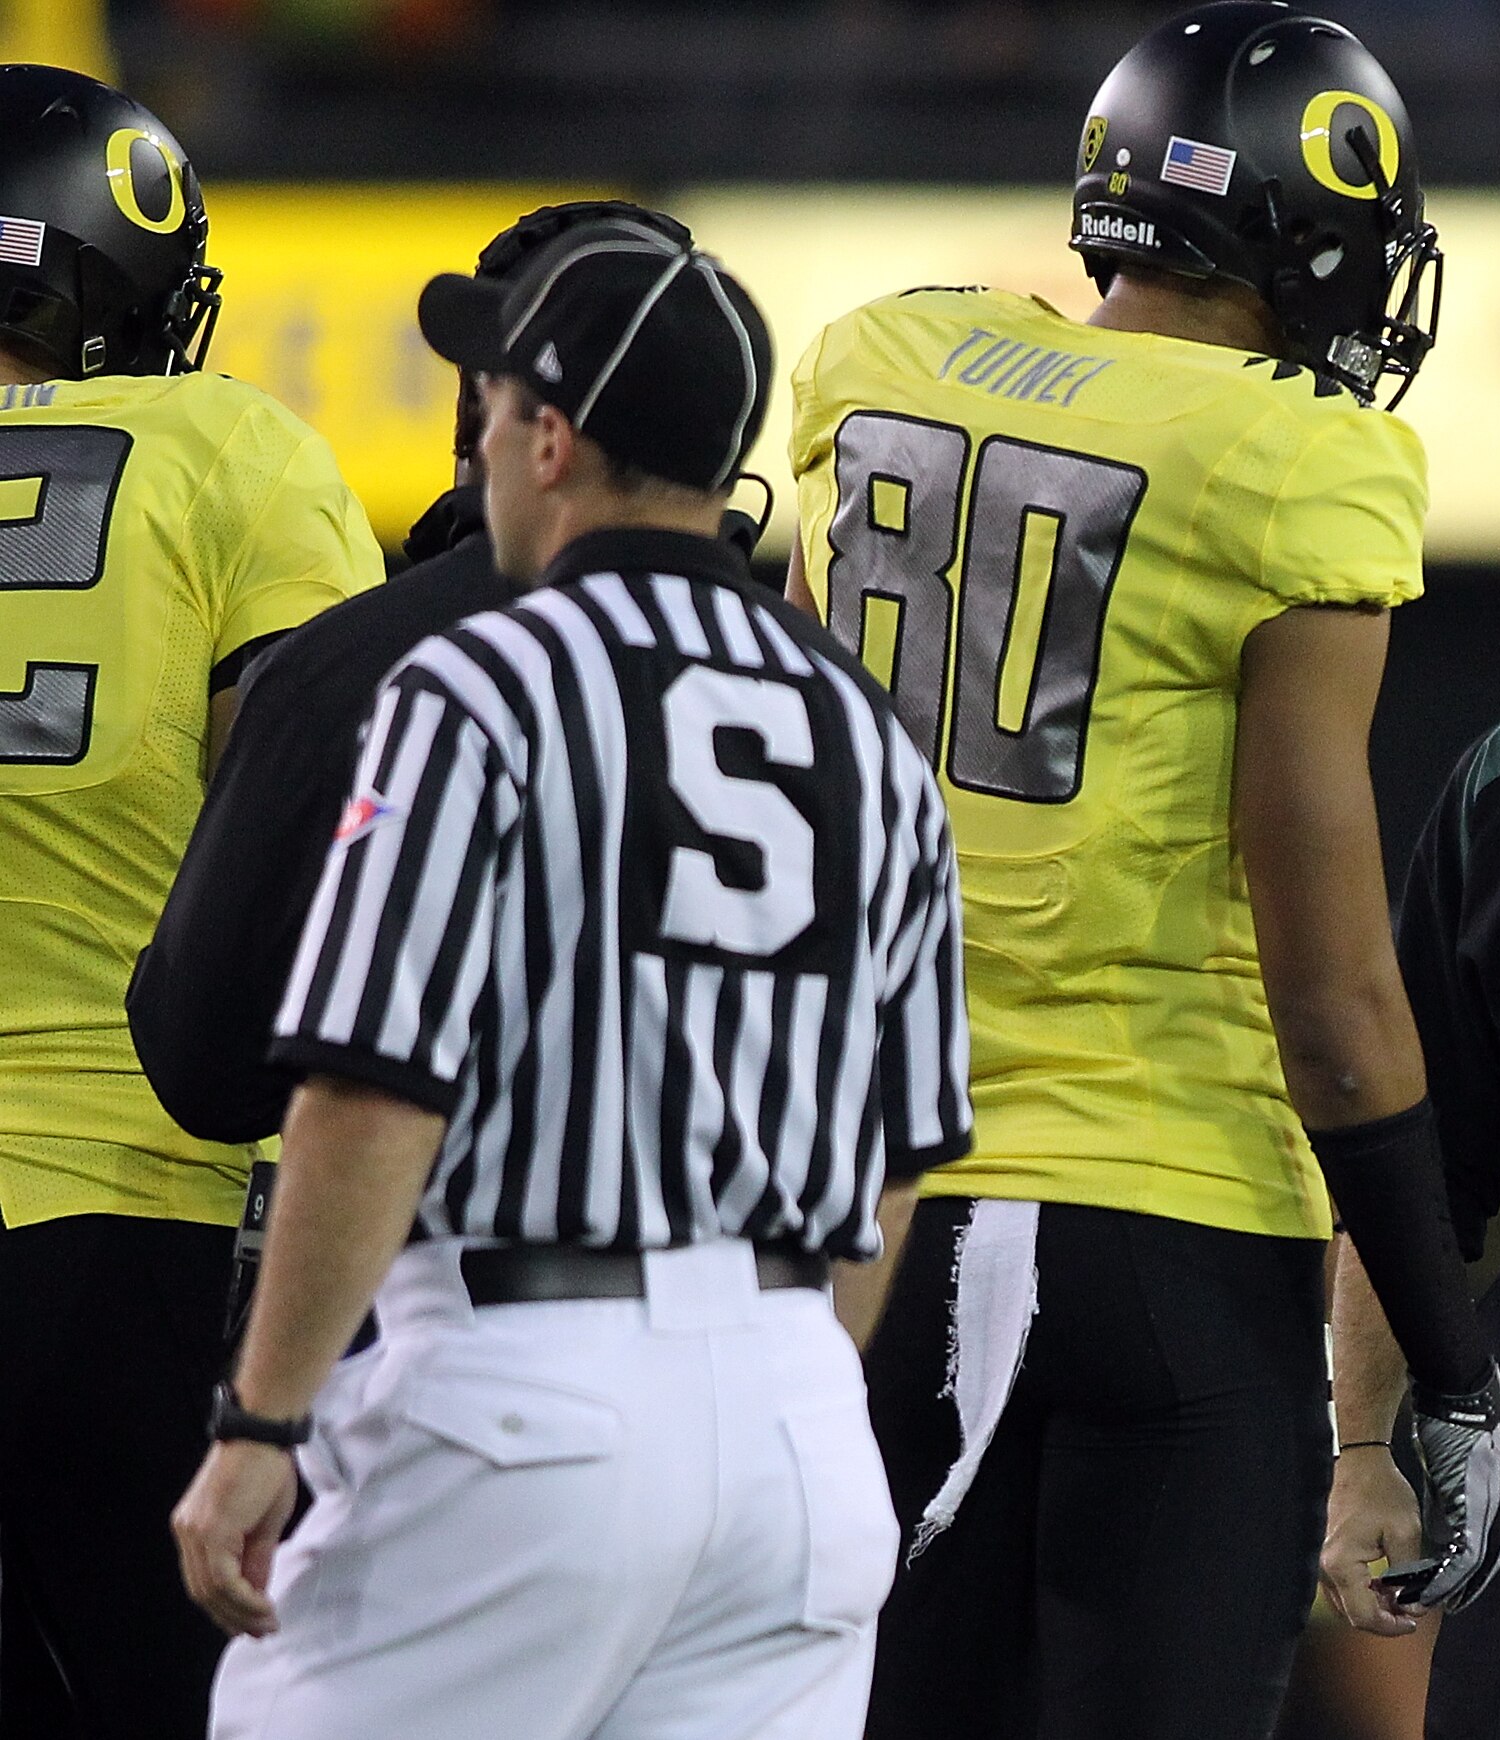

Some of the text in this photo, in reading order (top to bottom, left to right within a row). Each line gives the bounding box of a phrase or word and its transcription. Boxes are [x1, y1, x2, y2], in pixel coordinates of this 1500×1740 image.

[106, 128, 186, 234] O
[1109, 172, 1129, 196] 80
[1301, 90, 1399, 199] O
[940, 327, 1117, 407] TUINEI
[827, 409, 1149, 805] 80
[661, 663, 816, 958] S
[254, 1193, 265, 1220] 9
